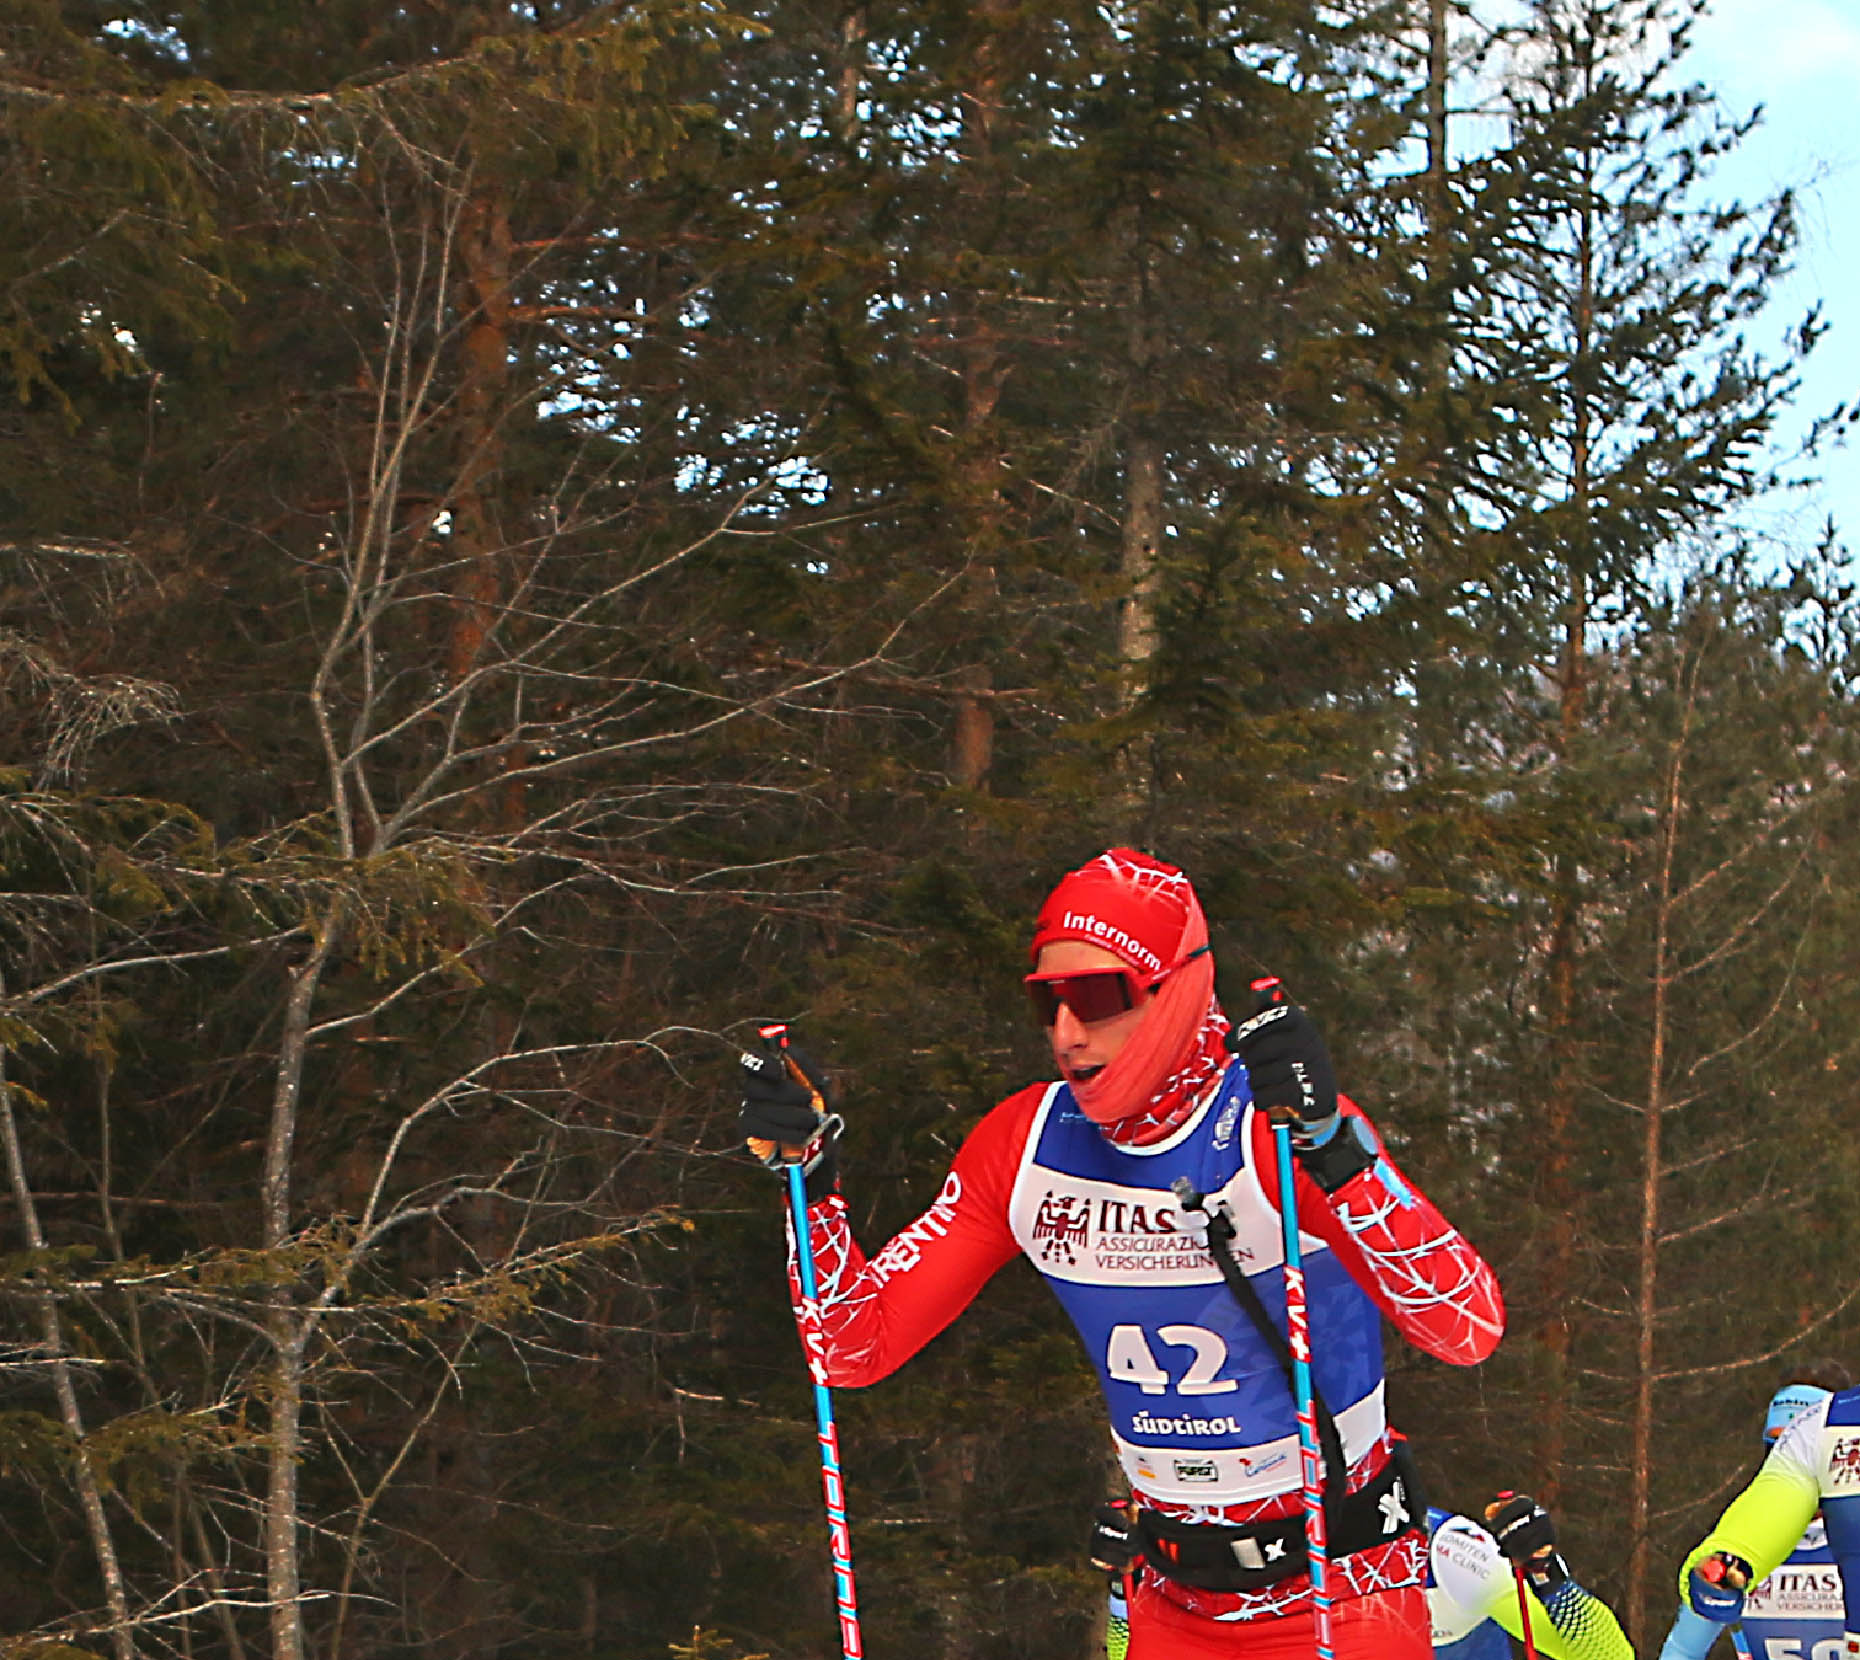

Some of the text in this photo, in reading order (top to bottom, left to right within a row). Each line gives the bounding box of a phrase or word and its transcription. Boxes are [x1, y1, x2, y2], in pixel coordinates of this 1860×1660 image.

[1062, 911, 1162, 971] Internorm
[1100, 1198, 1176, 1233] ITAS
[1106, 1324, 1240, 1396] 42
[1778, 1573, 1837, 1591] ITAS
